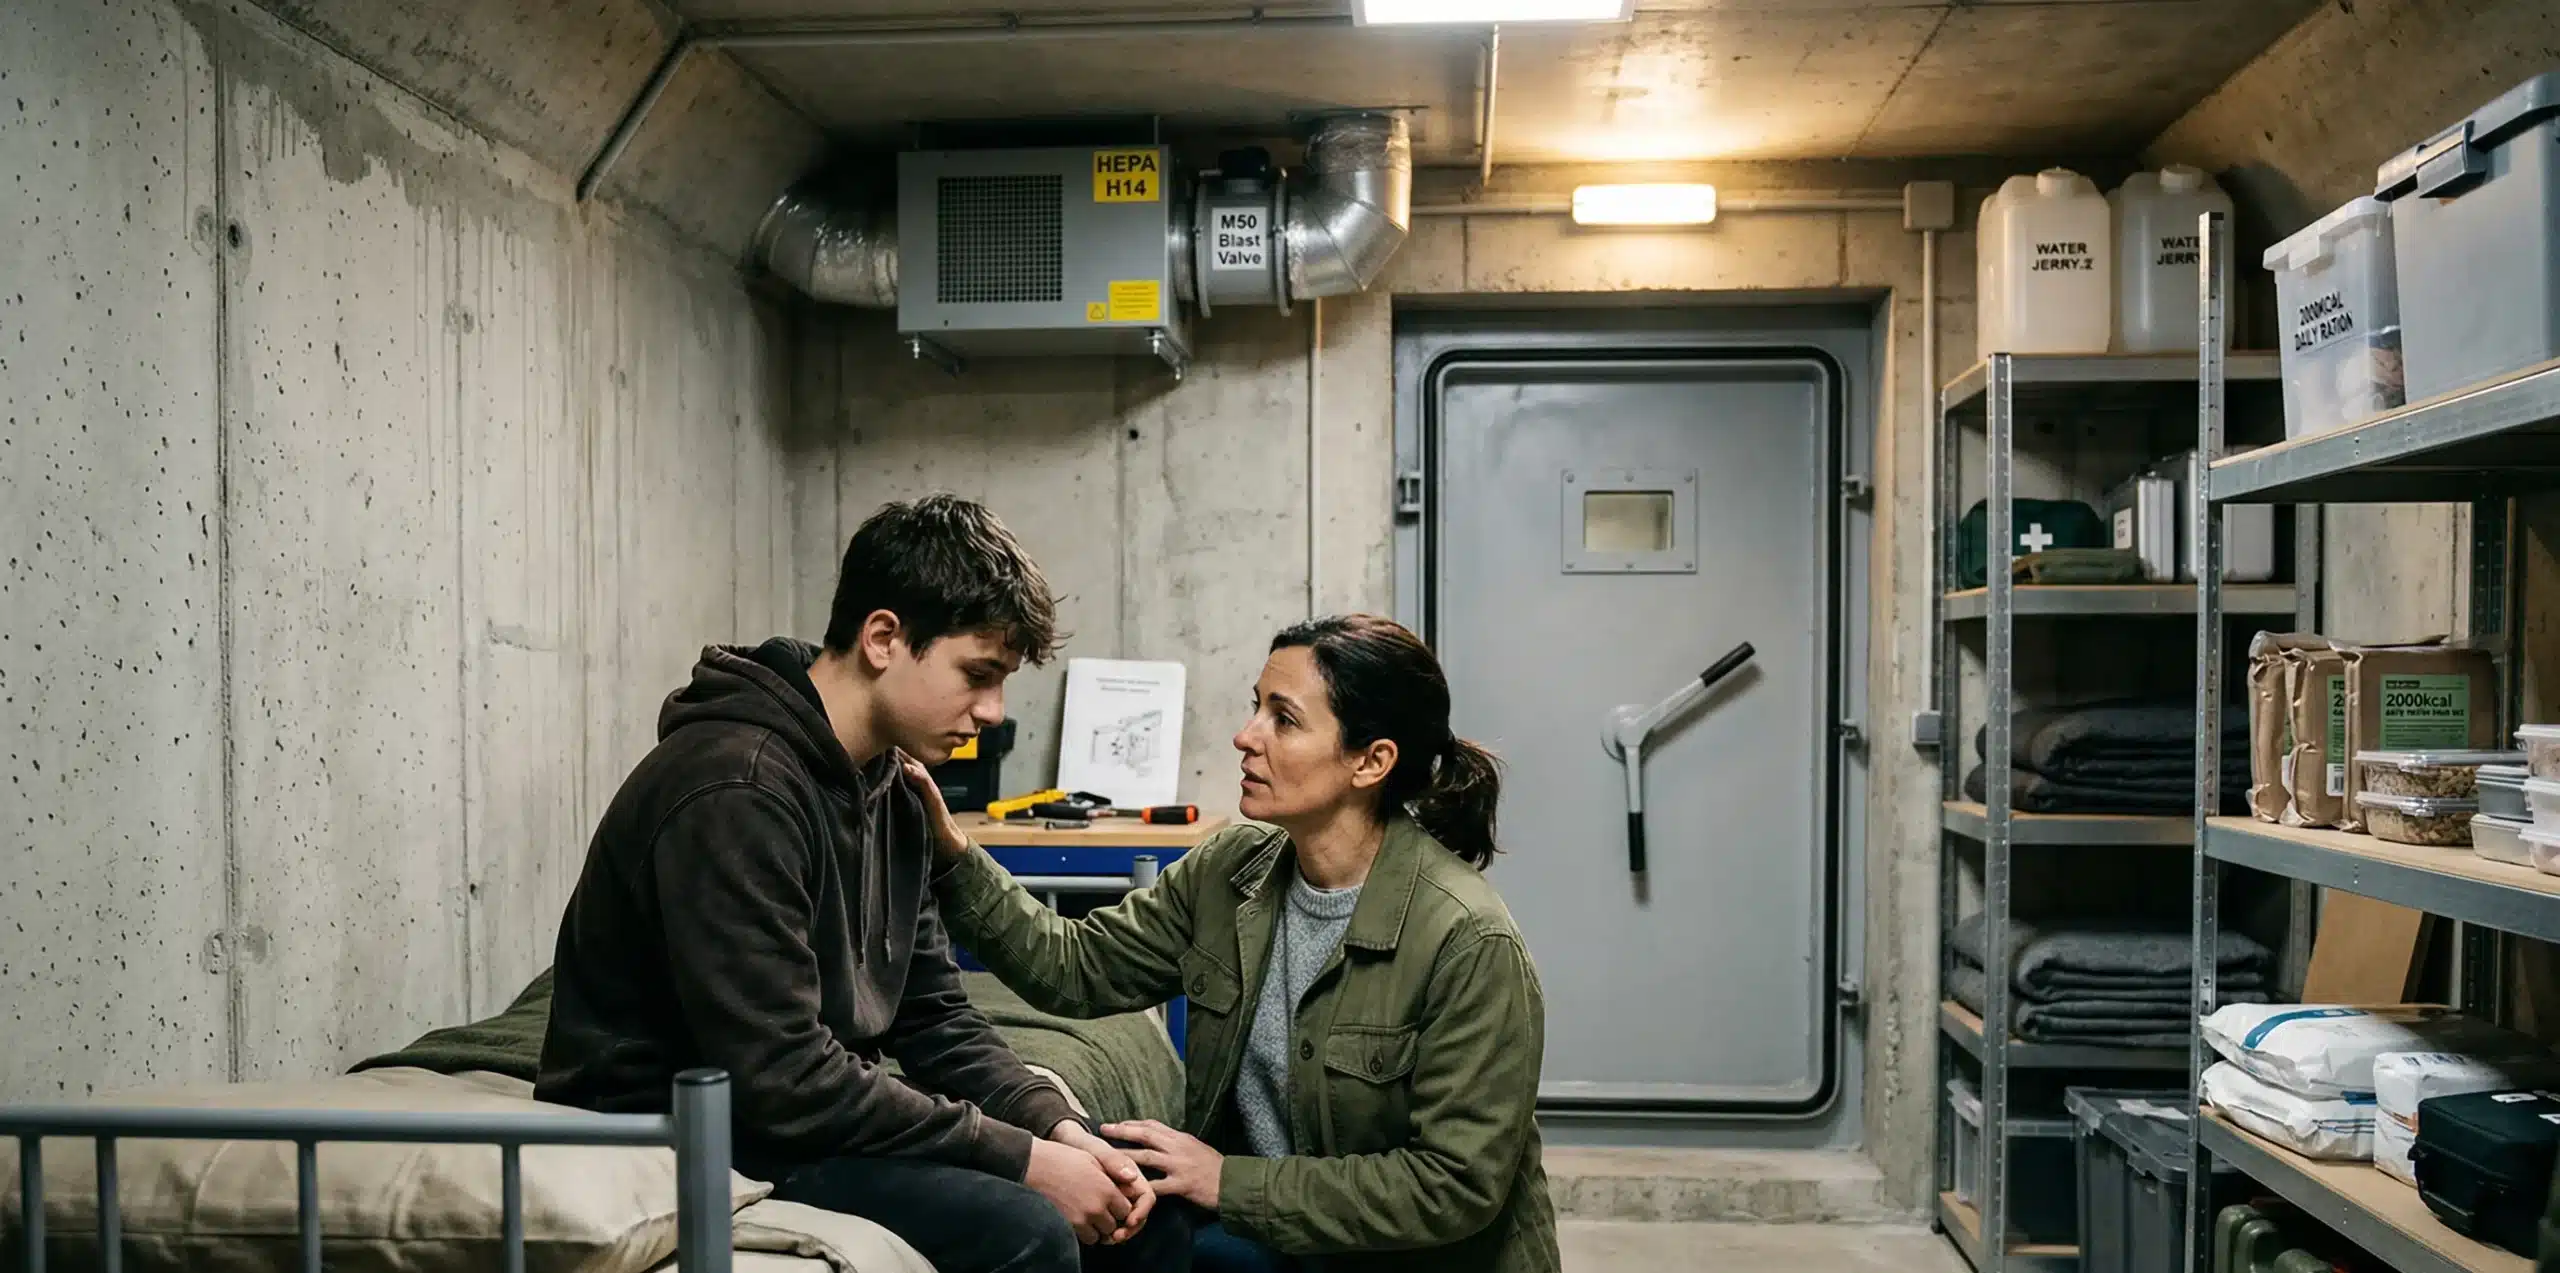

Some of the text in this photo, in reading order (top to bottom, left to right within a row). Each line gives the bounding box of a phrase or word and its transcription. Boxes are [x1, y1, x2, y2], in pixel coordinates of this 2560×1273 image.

[1097, 155, 1156, 173] HEPA
[1106, 179, 1148, 197] H14
[1221, 215, 1258, 229] M50
[1219, 234, 1261, 248] Blast
[2160, 236, 2200, 249] WATE
[2036, 243, 2088, 255] WATER
[1218, 252, 1262, 265] Valve
[2385, 693, 2453, 707] 2000kcal
